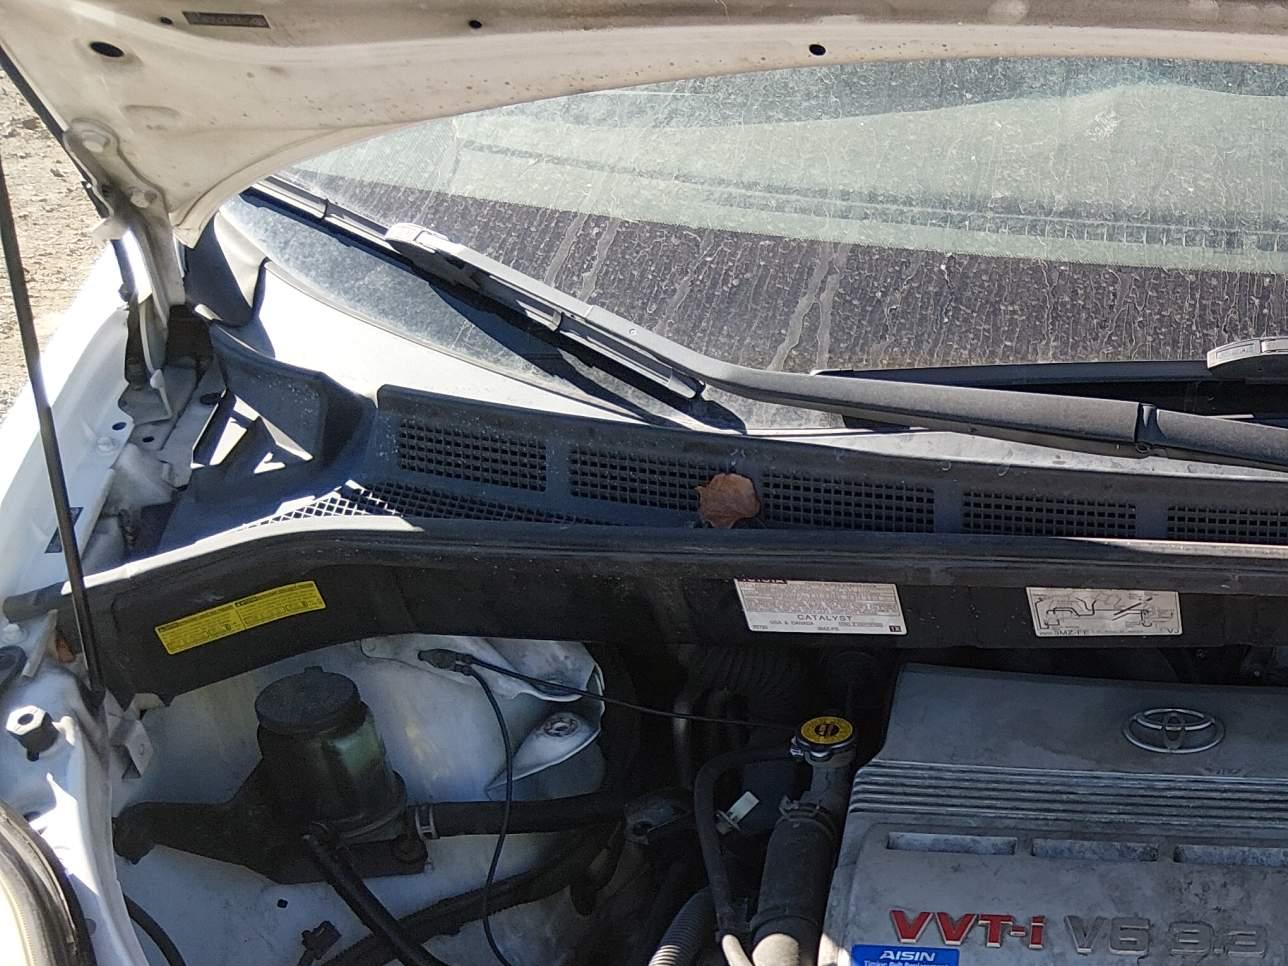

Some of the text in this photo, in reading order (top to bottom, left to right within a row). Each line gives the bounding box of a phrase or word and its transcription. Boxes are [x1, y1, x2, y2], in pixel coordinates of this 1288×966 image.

[797, 614, 853, 622] CATALYST
[889, 908, 1047, 950] VVT-i
[1063, 914, 1152, 957] V6
[879, 950, 936, 962] AISIN
